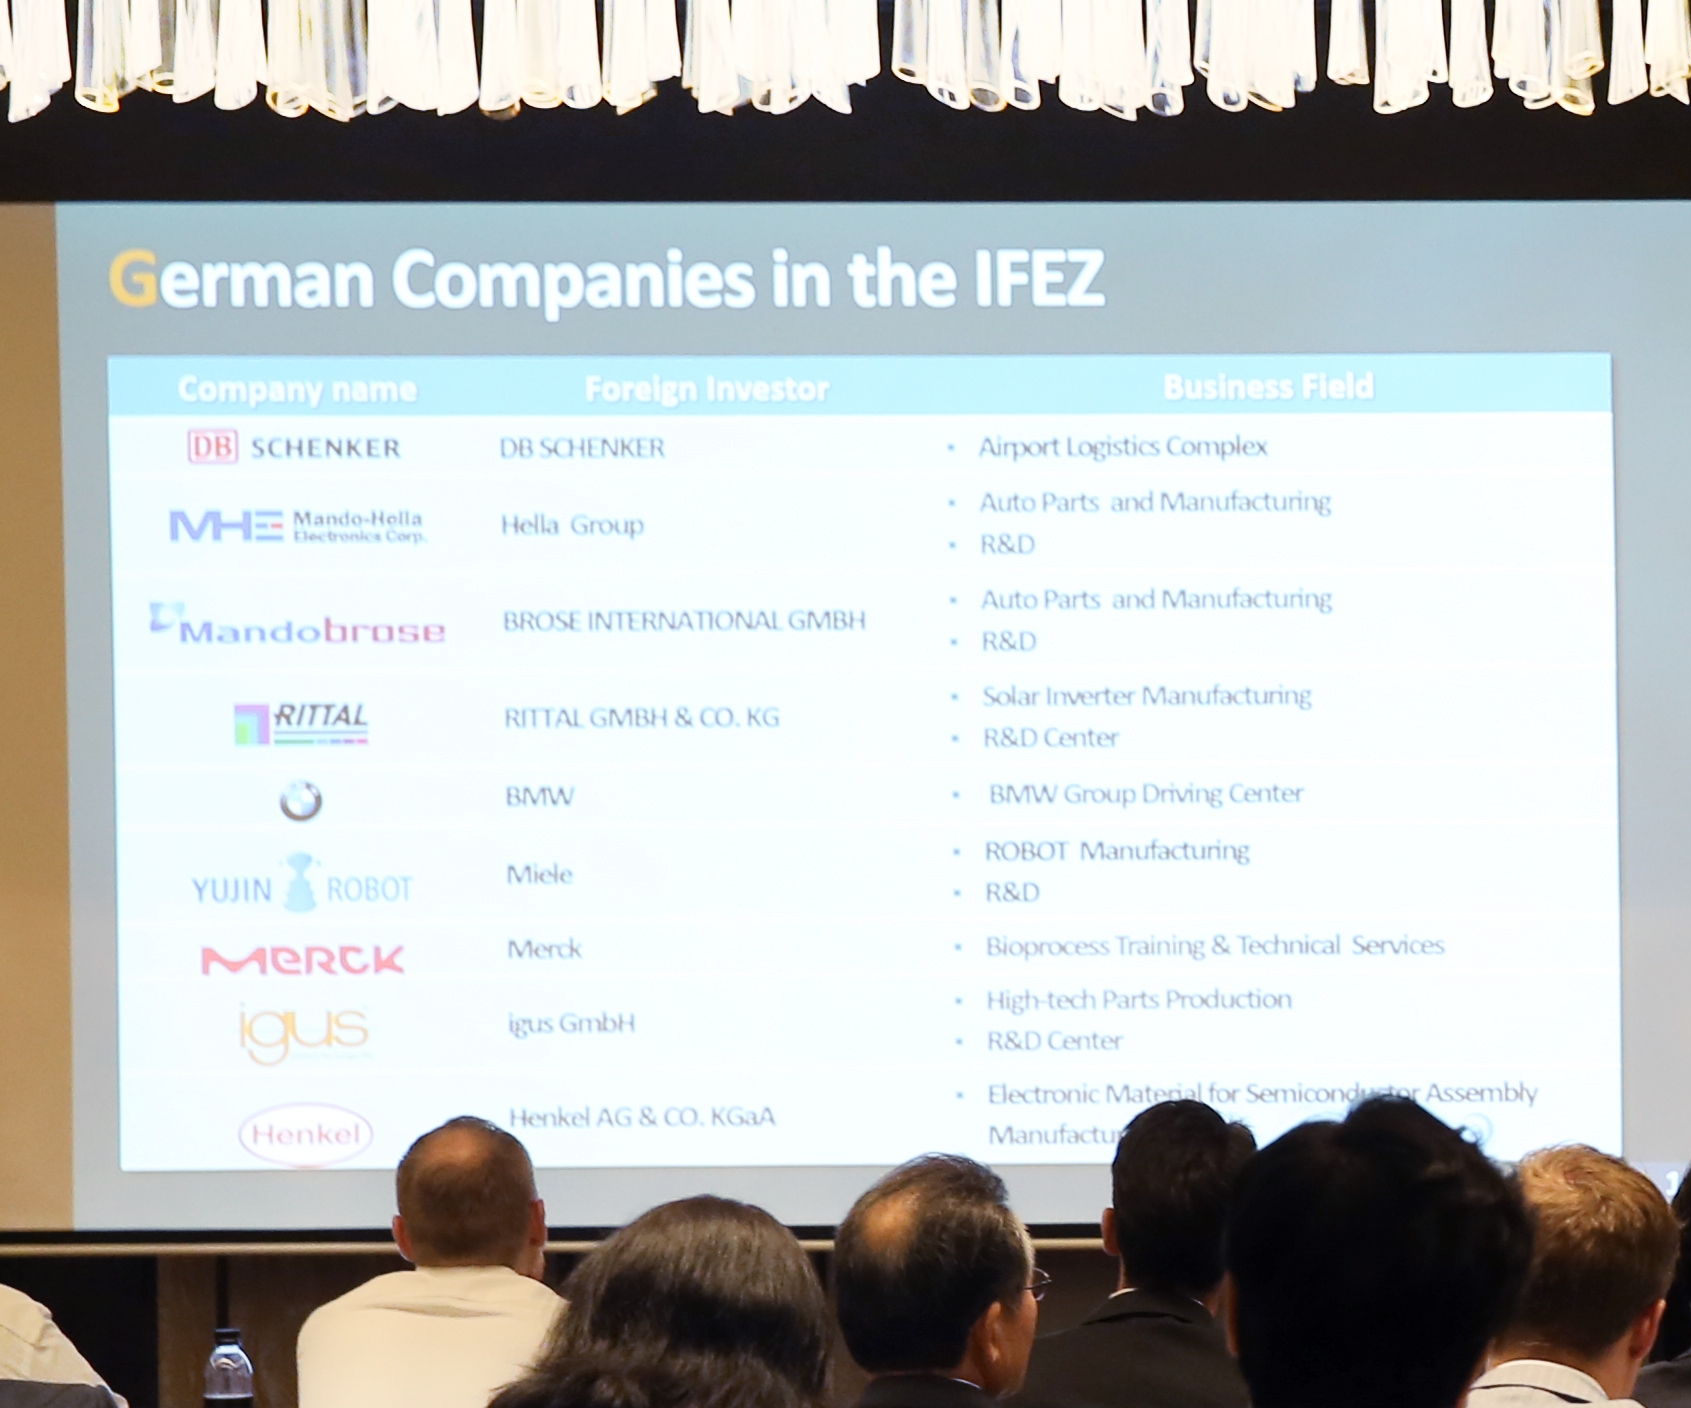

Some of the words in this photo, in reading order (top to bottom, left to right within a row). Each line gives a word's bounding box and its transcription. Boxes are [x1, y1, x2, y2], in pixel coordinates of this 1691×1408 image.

[110, 249, 373, 308] German
[393, 248, 755, 322] Companies
[773, 248, 830, 307] in
[847, 246, 957, 308] the
[976, 249, 1105, 306] IFEZ
[178, 374, 324, 410] Company
[333, 380, 419, 404] name
[586, 374, 699, 409] Foreign
[707, 375, 830, 404] Investor
[1164, 372, 1295, 402] Business
[1303, 371, 1376, 401] Field
[193, 434, 233, 459] DB
[252, 439, 399, 457] SCHENKER
[501, 438, 534, 458] DB
[540, 438, 664, 457] SCHENKER
[979, 437, 1059, 462] Airport
[1067, 436, 1160, 462] Logistics
[1166, 435, 1267, 461] Complex
[980, 492, 1036, 512] Auto
[1042, 492, 1099, 512] Parts
[1111, 491, 1153, 512] and
[1161, 489, 1332, 517] Manufacturing
[294, 511, 422, 526] Mando-Hella
[502, 514, 559, 534] Hella
[571, 515, 644, 540] Group
[982, 534, 1035, 554] R&D
[982, 590, 1038, 609] Auto
[1044, 590, 1101, 609] Parts
[1113, 588, 1155, 609] and
[1162, 587, 1332, 614] Manufacturing
[504, 611, 579, 631] BROSE
[589, 611, 778, 631] INTERNATIONAL
[788, 610, 865, 630] GMBH
[983, 631, 1037, 651] R&D
[984, 685, 1040, 706] Solar
[1047, 687, 1136, 705] Inverter
[1143, 684, 1312, 710] Manufacturing
[273, 703, 369, 728] RITTAL
[505, 708, 581, 728] RITTAL
[590, 708, 667, 727] GMBH
[675, 707, 693, 727] &
[700, 707, 740, 727] CO.
[747, 708, 779, 727] KG
[985, 727, 1038, 747] R&D
[1044, 728, 1119, 747] Center
[507, 787, 574, 806] BMW
[990, 785, 1057, 804] BMW
[1064, 784, 1136, 809] Group
[1143, 783, 1223, 808] Driving
[1229, 784, 1304, 803] Center
[986, 842, 1066, 861] ROBOT
[1081, 839, 1250, 865] Manufacturing
[507, 863, 573, 884] Miele
[192, 877, 271, 903] YUJIN
[328, 876, 413, 902] ROBOT
[987, 882, 1040, 902] R&D
[508, 938, 581, 958] Merck
[987, 936, 1110, 961] Bioprocess
[1116, 935, 1206, 961] Training
[1212, 935, 1230, 954] &
[1238, 934, 1340, 955] Technical
[1353, 935, 1445, 955] Services
[988, 989, 1096, 1015] High-tech
[1103, 990, 1160, 1009] Parts
[1167, 988, 1292, 1009] Production
[237, 1003, 370, 1067] igus
[509, 1013, 554, 1039] igus
[559, 1012, 635, 1033] GmbH
[988, 1031, 1041, 1050] R&D
[1048, 1031, 1123, 1050] Center
[989, 1083, 1098, 1104] Electronic
[1105, 1083, 1202, 1106] Material
[1207, 1083, 1241, 1105] for
[1425, 1081, 1538, 1107] Assembly
[511, 1107, 591, 1128] Henkel
[597, 1108, 632, 1127] AG
[639, 1107, 657, 1126] &
[664, 1107, 704, 1126] CO.
[712, 1107, 776, 1126] KGaA
[252, 1121, 361, 1146] Henkel
[988, 1123, 1124, 1146] Manufactur
